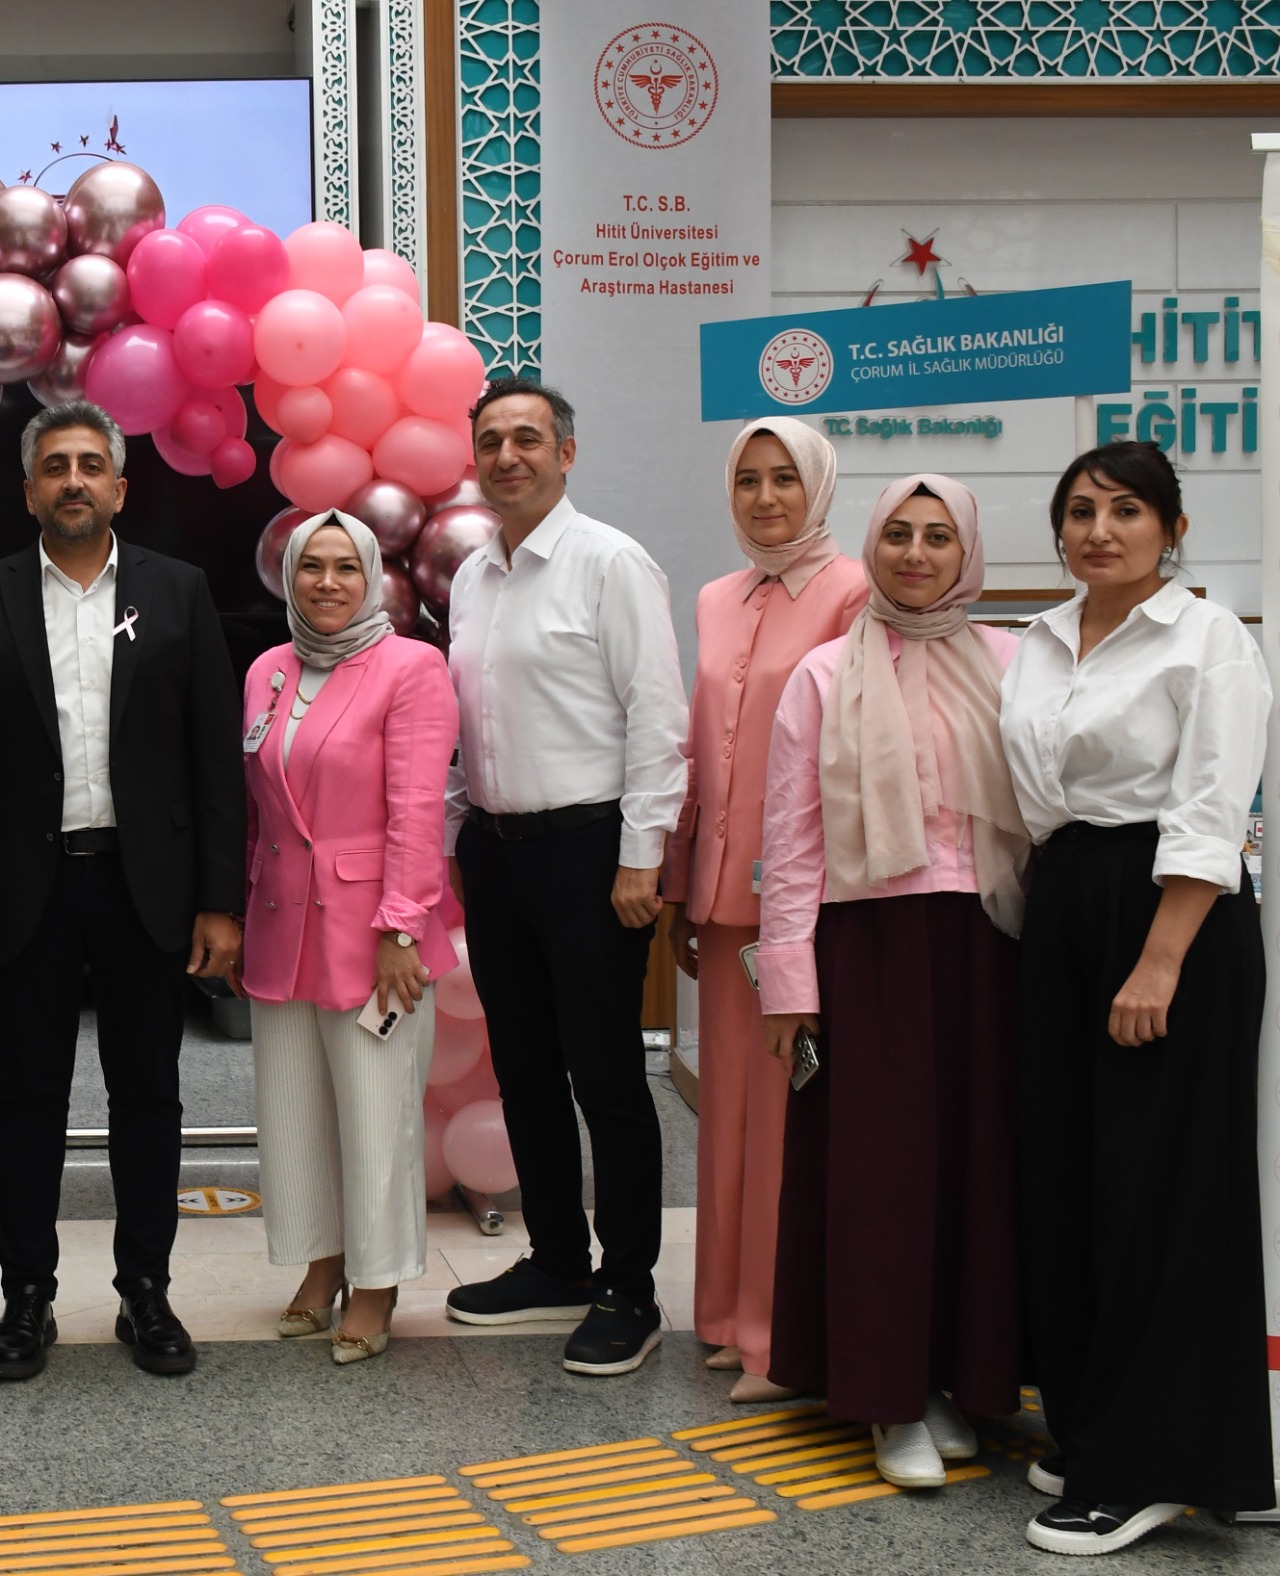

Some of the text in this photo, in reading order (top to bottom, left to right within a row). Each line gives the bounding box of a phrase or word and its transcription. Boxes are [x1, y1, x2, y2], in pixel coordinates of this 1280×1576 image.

[618, 45, 664, 82] CUMHURİYETİ
[666, 48, 692, 73] SAĞLIK
[674, 74, 695, 120] BAKANLIĞI
[623, 195, 691, 211] T.C. S.B.
[596, 222, 718, 239] Hitit Üniversitesi
[553, 250, 760, 271] Çorum Erol Olçok Eğitim ve
[581, 278, 734, 297] Araştırma Hastanesi
[848, 323, 1064, 361] T.C. SAĞLIK BAKANLIĞI
[850, 348, 1064, 383] ÇORUM İL SAĞLIK MÜDÜRLÜĞÜ
[855, 416, 912, 440] Sağlık
[918, 416, 1002, 440] Bakanlığı
